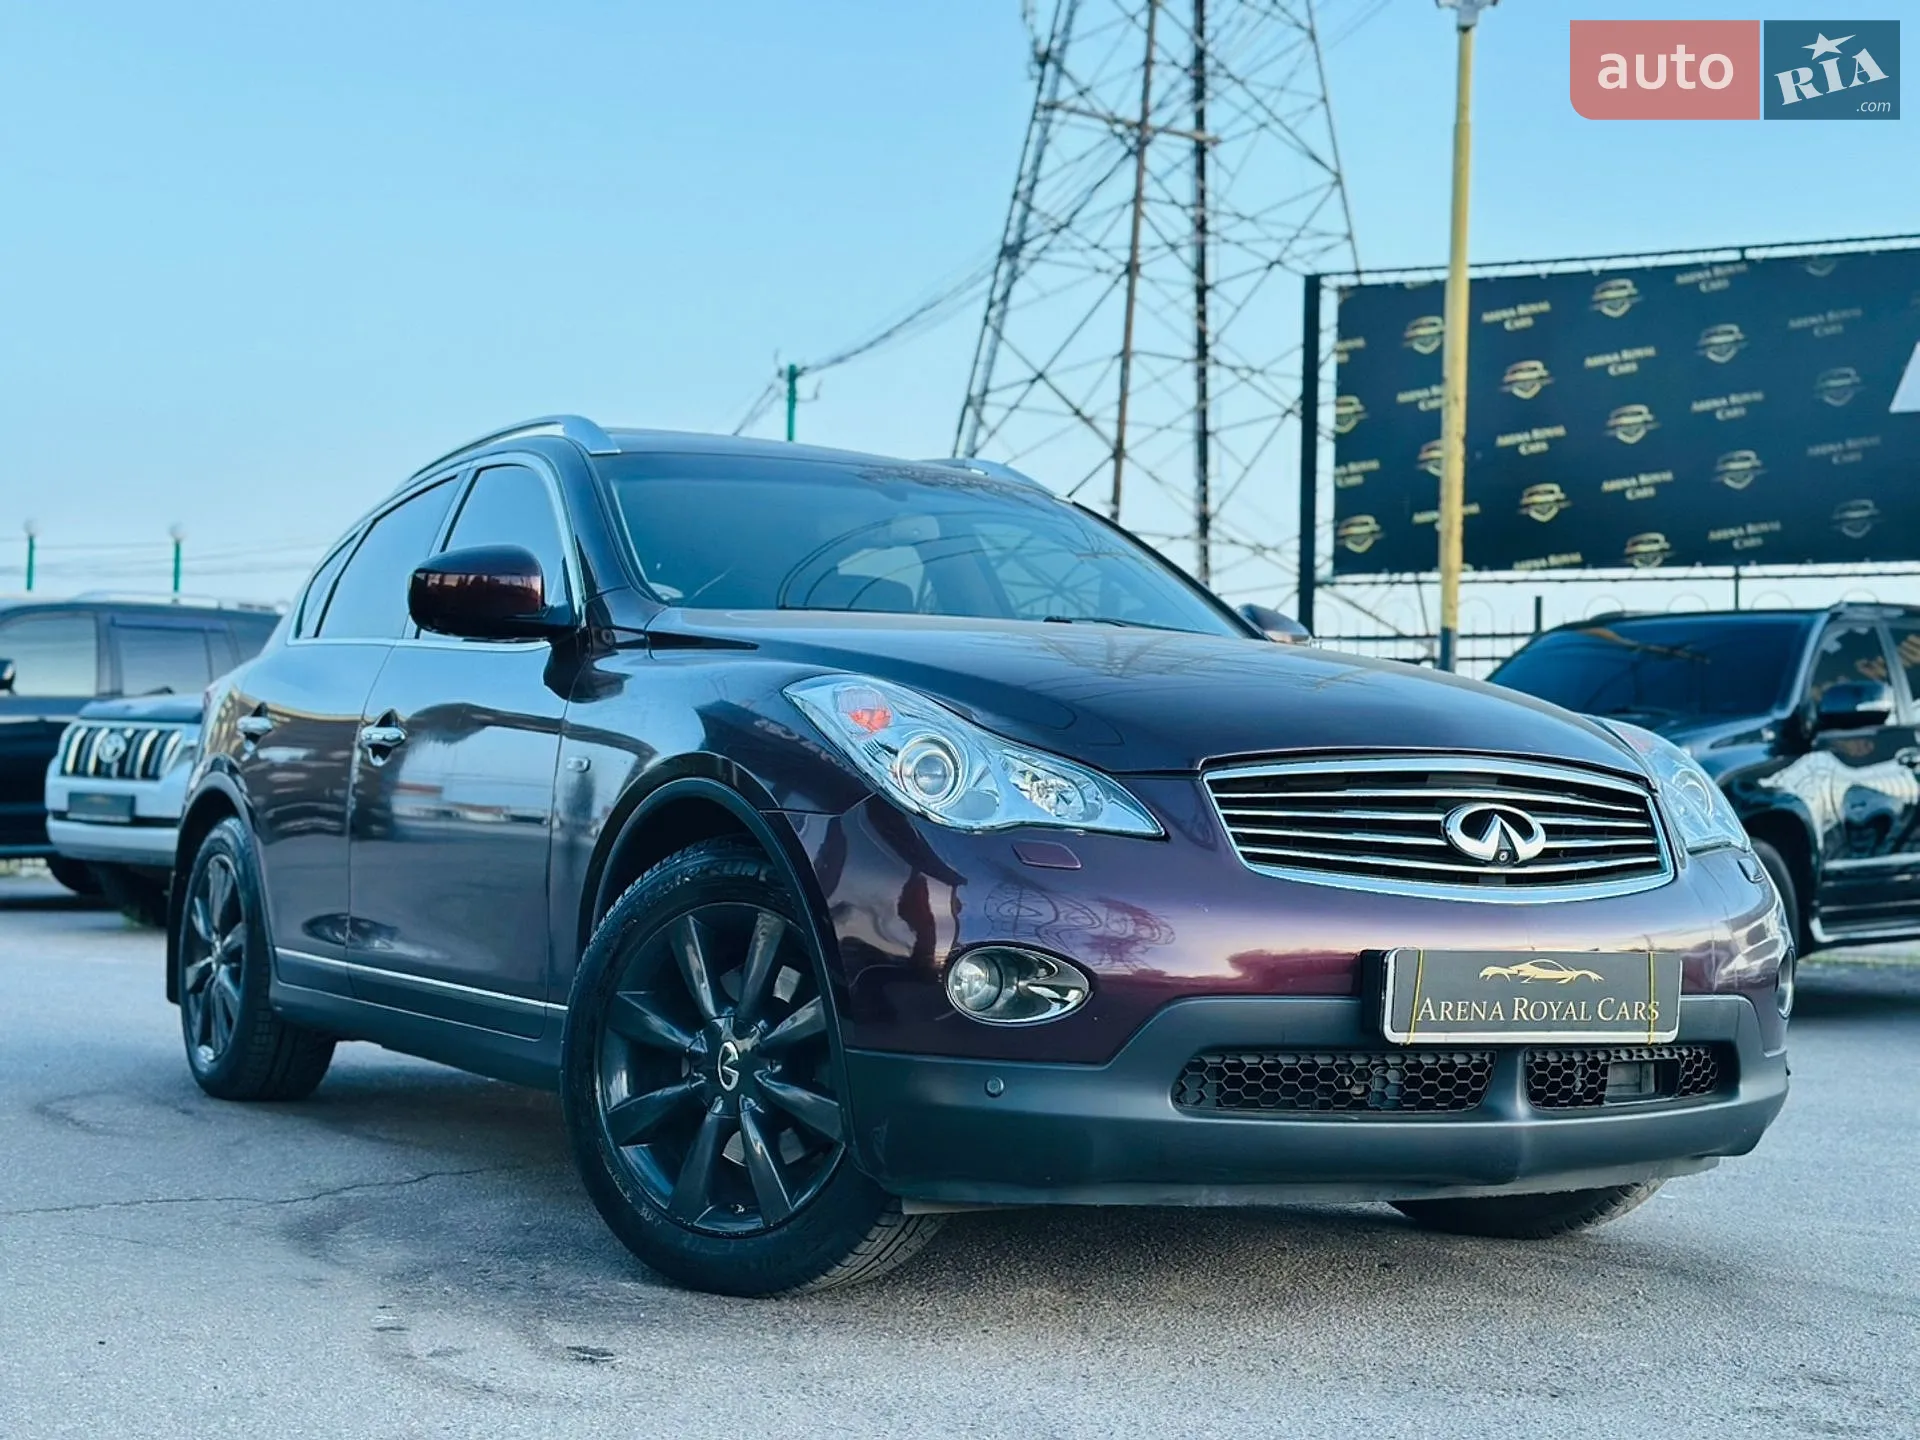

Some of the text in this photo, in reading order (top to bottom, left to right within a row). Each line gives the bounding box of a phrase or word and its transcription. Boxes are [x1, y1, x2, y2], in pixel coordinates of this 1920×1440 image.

[1416, 997, 1660, 1022] ARENA ROYAL CARS
